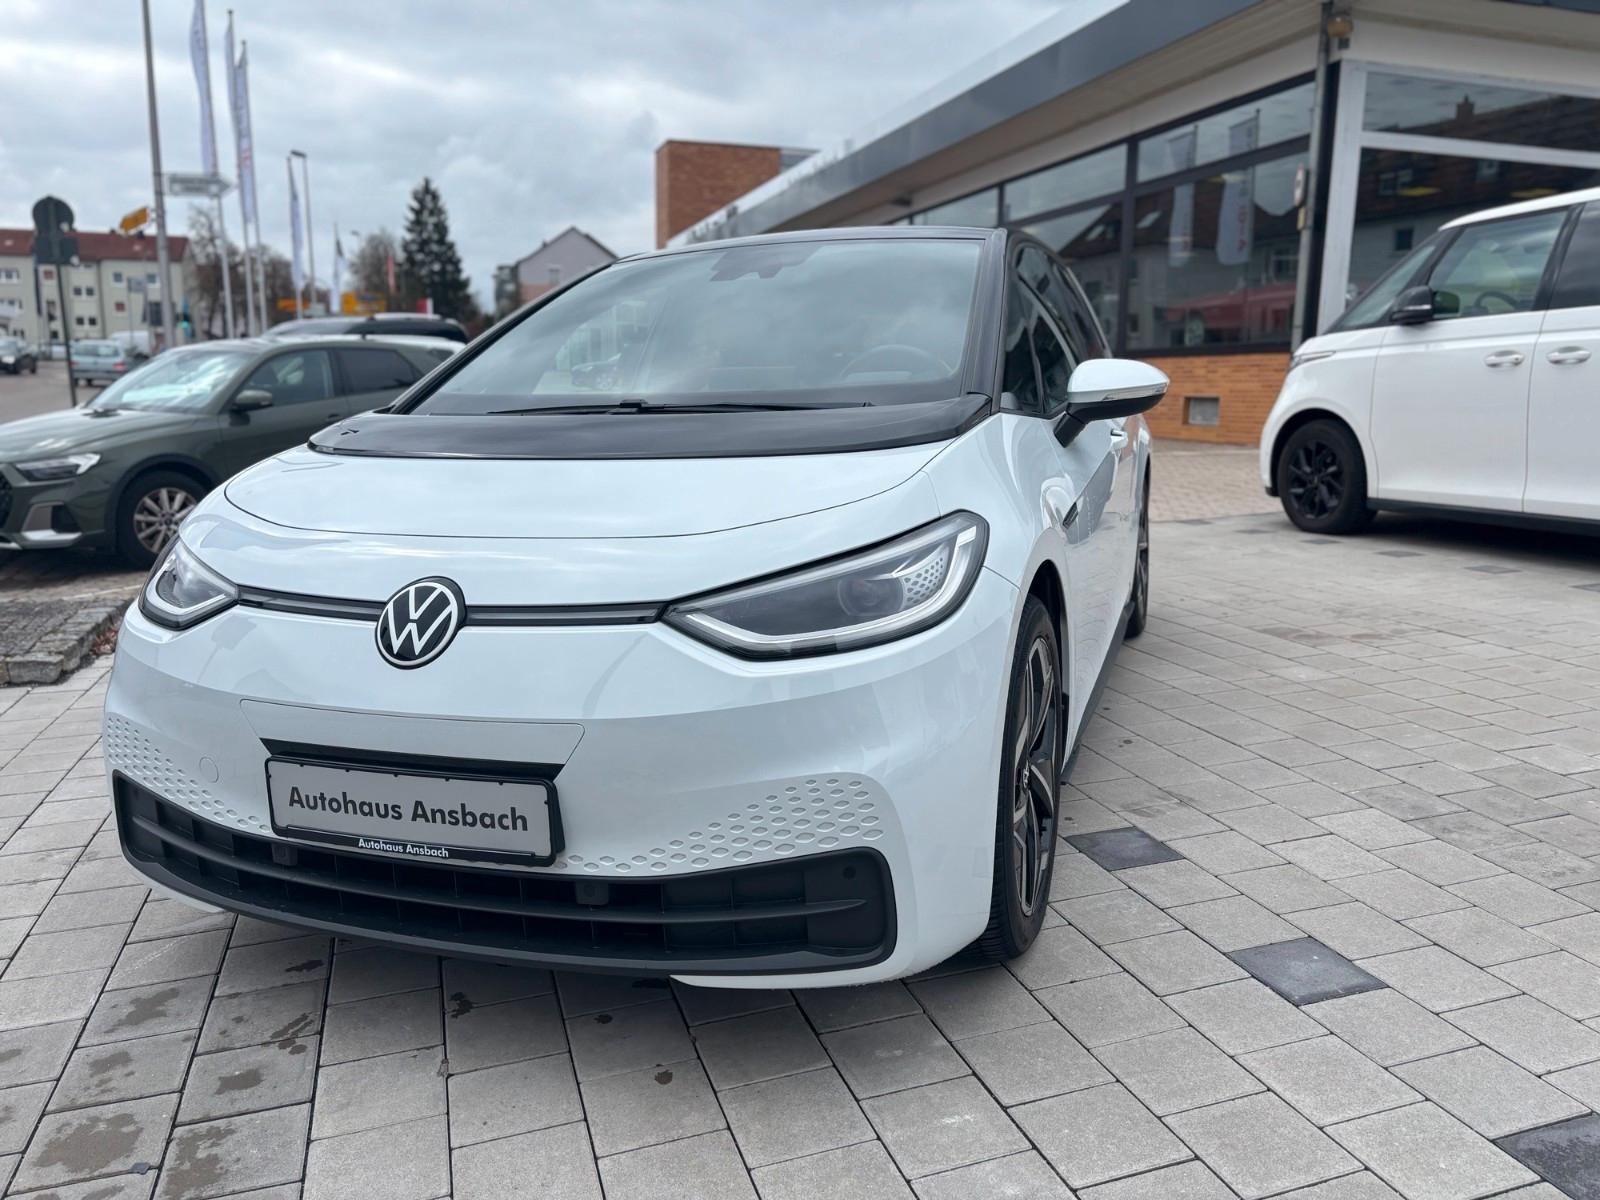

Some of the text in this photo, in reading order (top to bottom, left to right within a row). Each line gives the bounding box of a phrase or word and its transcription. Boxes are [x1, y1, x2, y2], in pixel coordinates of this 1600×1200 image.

[384, 584, 455, 658] VW
[288, 786, 529, 832] Autohaus Ansbach
[358, 838, 449, 858] Autohaus Ansbach
